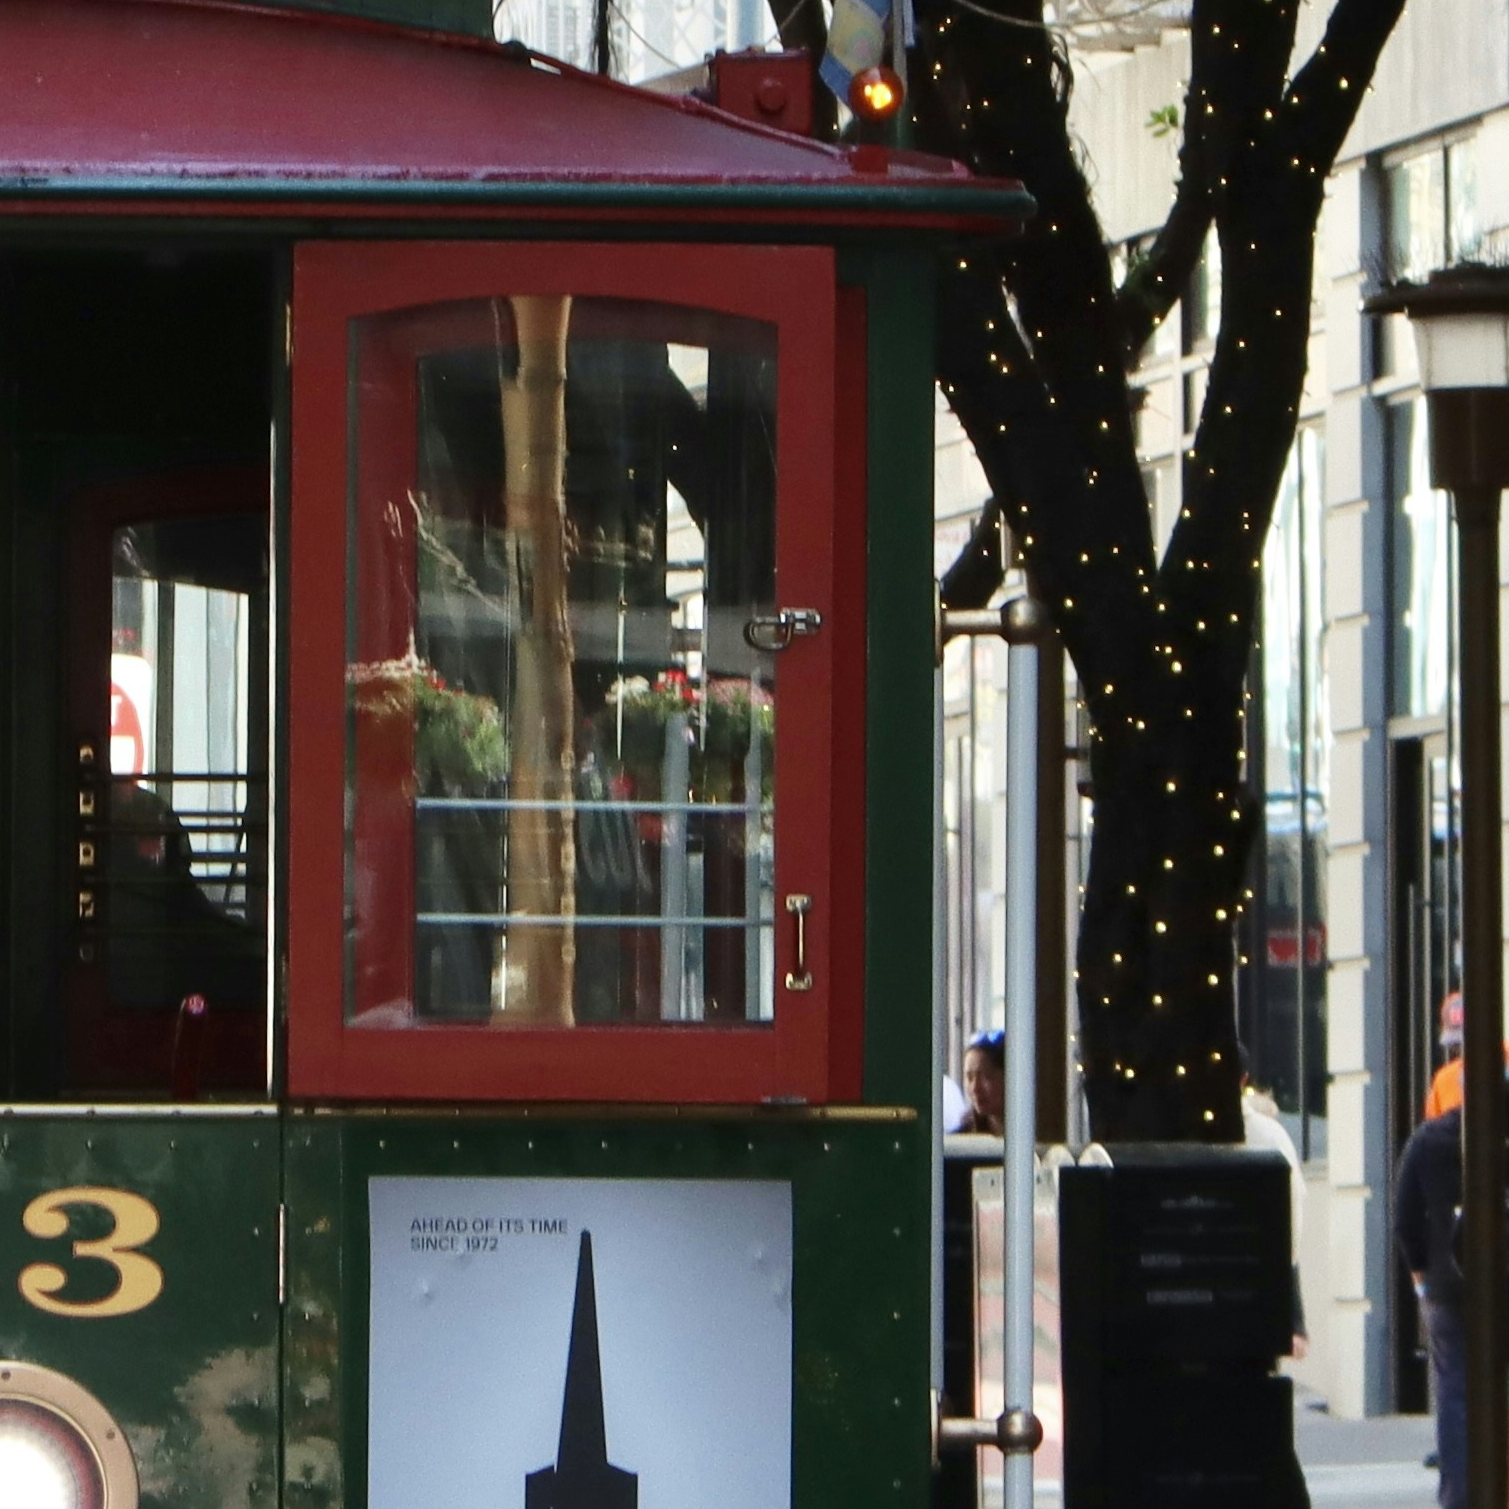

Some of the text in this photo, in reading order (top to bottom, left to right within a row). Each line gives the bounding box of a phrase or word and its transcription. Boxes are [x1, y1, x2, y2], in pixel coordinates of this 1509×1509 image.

[410, 1217, 568, 1234] AHEAD OF ITS TIME
[466, 1235, 499, 1252] 1972
